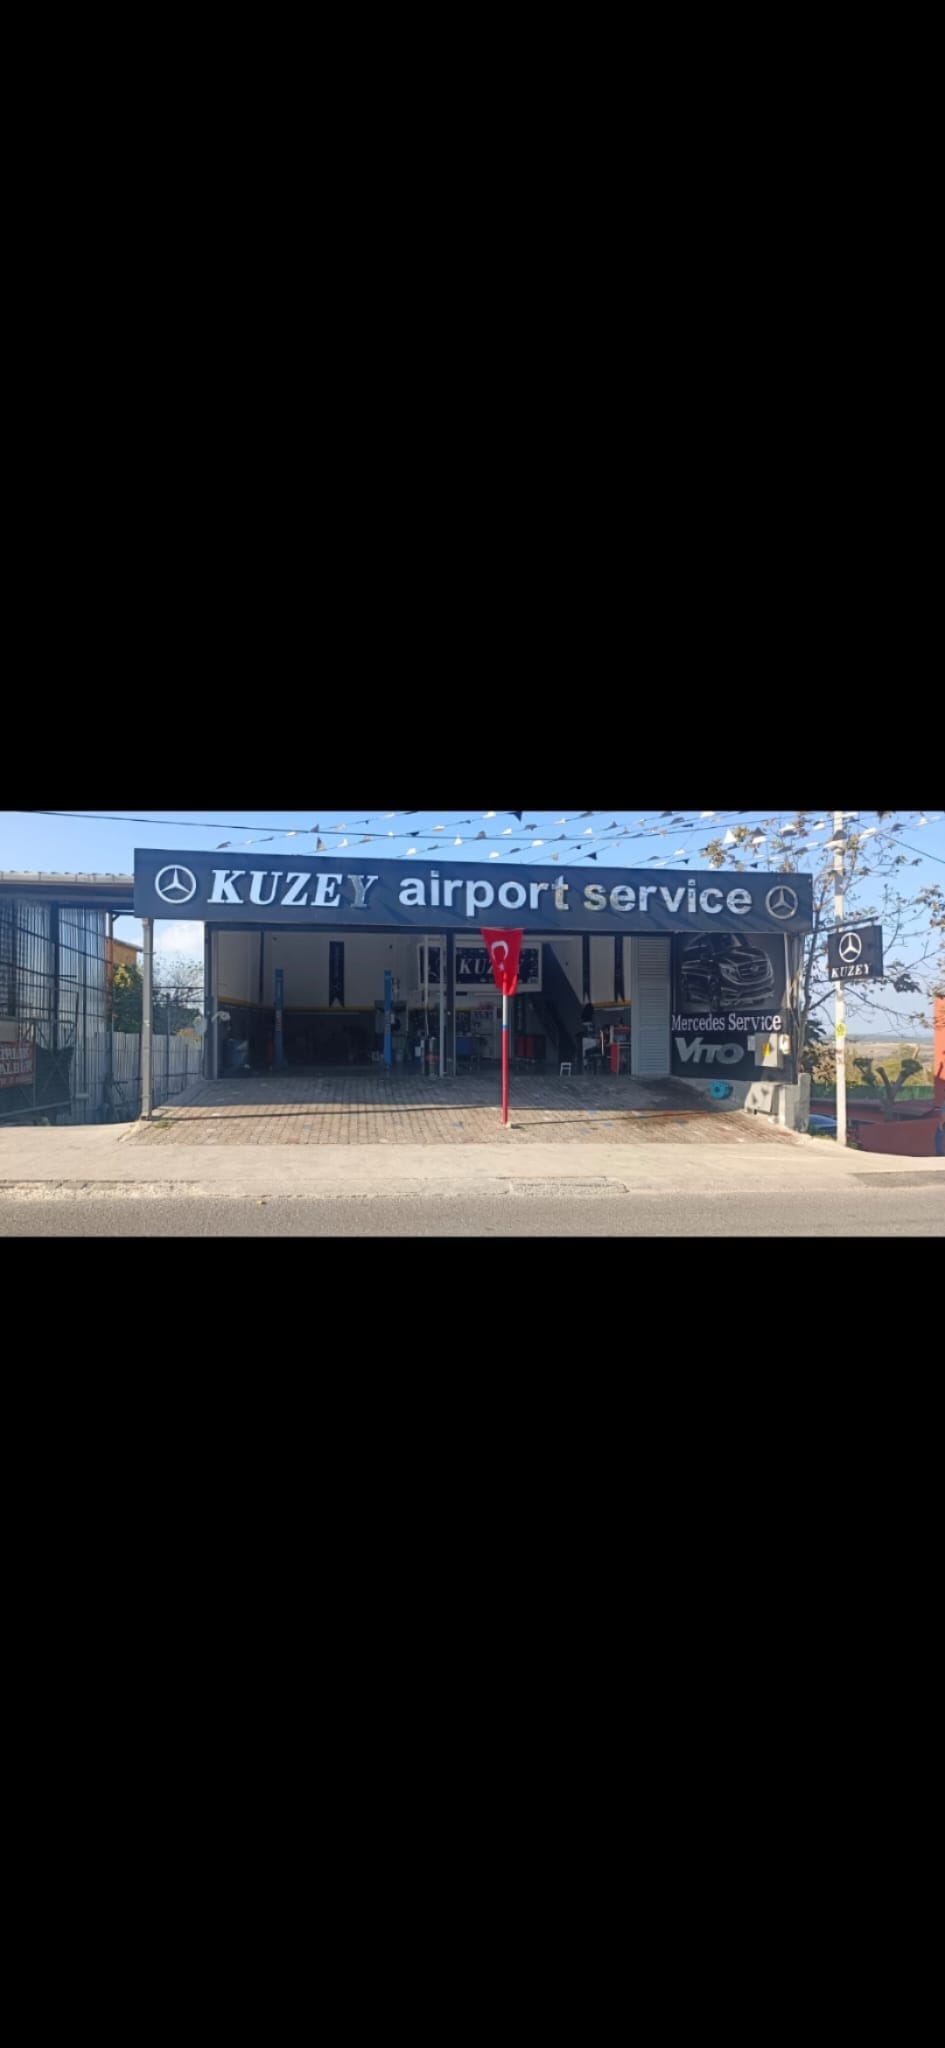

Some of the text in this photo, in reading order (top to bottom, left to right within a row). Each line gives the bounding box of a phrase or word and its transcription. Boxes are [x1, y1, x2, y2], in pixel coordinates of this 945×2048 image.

[207, 869, 752, 917] KUZEY airport service
[831, 963, 872, 978] KUZEY
[671, 1012, 782, 1031] Mercedes Service
